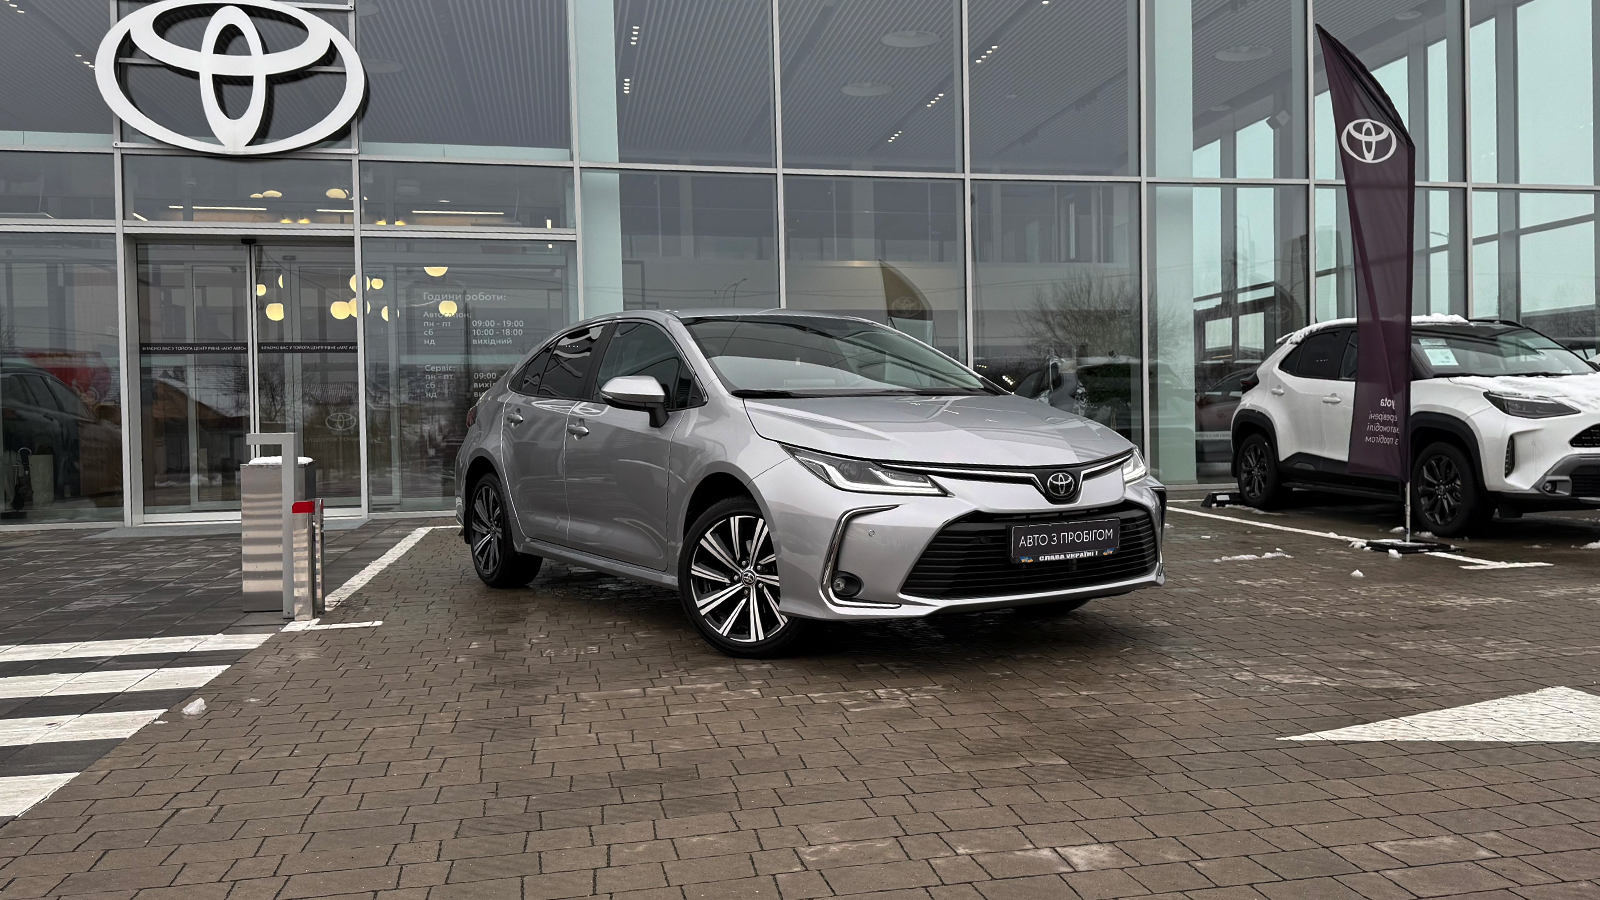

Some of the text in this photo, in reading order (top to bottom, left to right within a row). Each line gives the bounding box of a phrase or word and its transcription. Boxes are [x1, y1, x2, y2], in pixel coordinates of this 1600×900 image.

[423, 292, 506, 301] Години роботи:
[425, 364, 456, 373] Сервіс:
[473, 372, 497, 380] 09:00
[473, 381, 495, 389] вихі
[1019, 528, 1113, 547] АВТО З ПРОБІГОМ
[1039, 554, 1065, 562] СЛАВА
[1065, 551, 1094, 559] УКРАЇНІ
